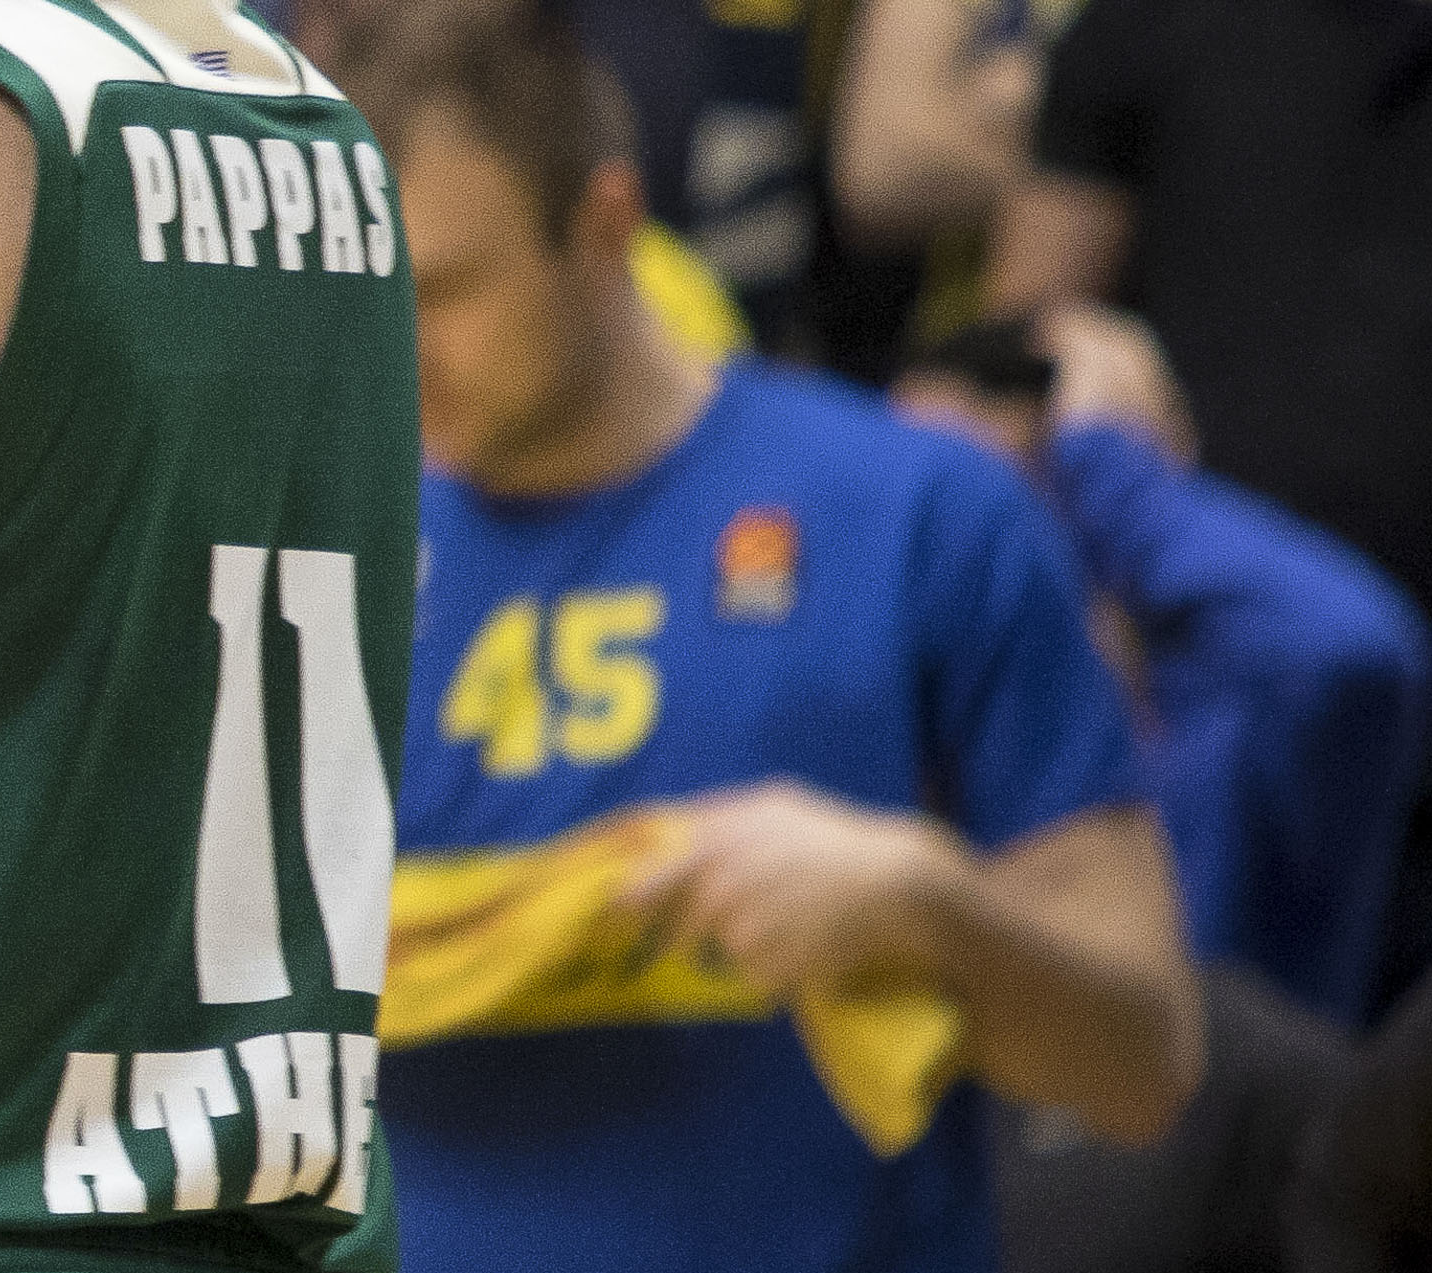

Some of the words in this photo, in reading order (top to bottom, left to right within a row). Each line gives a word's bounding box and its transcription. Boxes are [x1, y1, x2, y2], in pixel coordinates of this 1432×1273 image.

[119, 124, 397, 278] PAPPAS
[192, 543, 398, 1004] 11
[436, 586, 670, 778] 45
